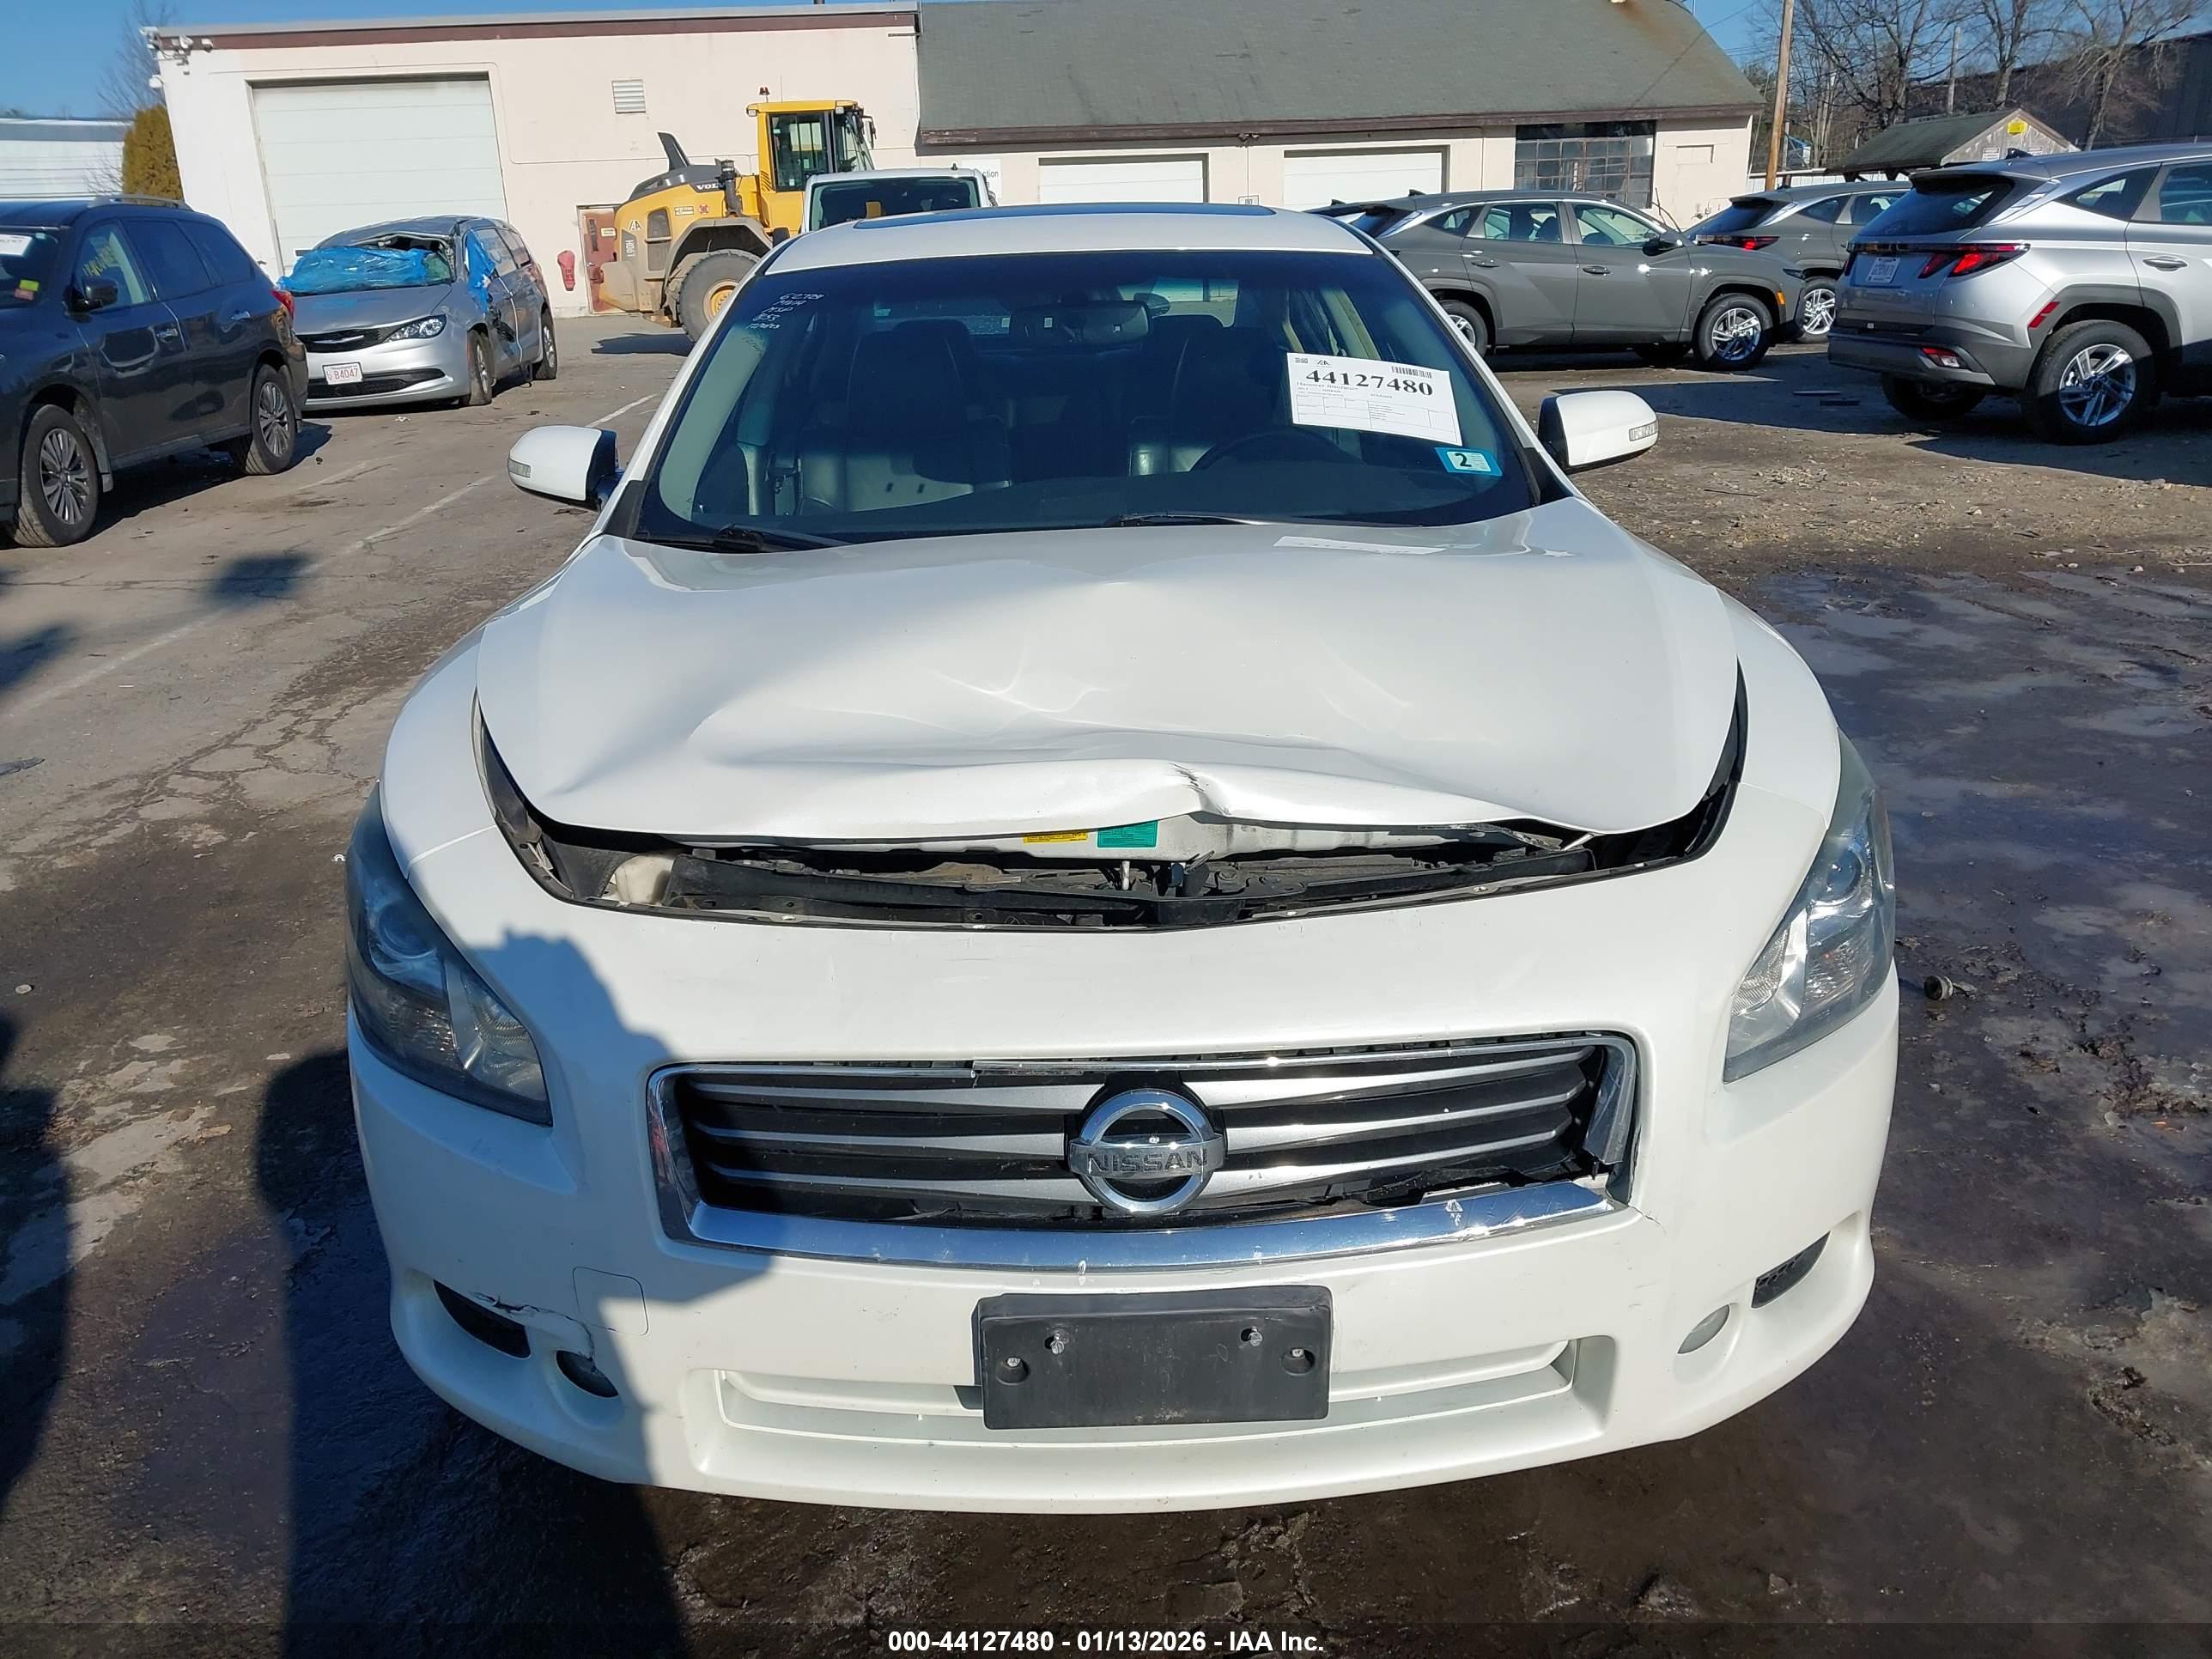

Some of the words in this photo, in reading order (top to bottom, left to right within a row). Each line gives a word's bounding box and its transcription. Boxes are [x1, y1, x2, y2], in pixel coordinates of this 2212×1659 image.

[1305, 369, 1433, 396] 44127480
[1455, 453, 1472, 467] 2
[1087, 1149, 1208, 1174] NISSAN
